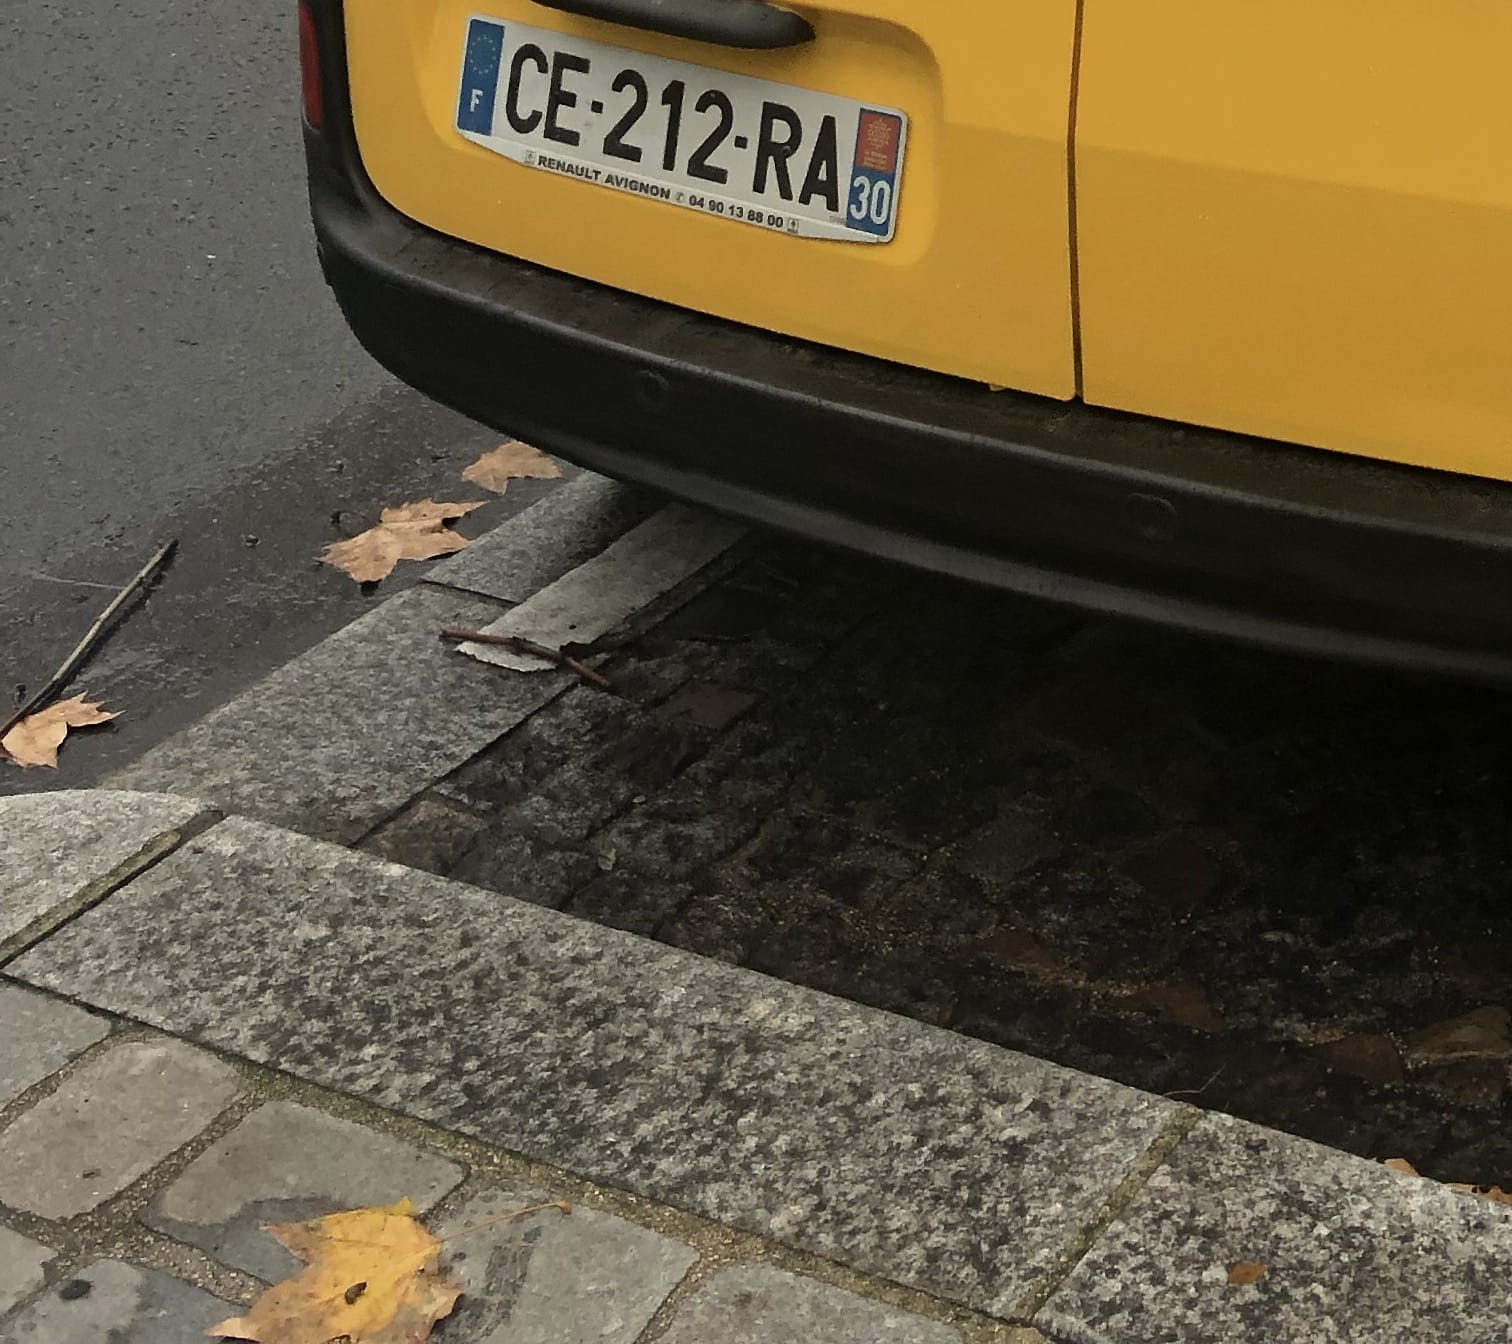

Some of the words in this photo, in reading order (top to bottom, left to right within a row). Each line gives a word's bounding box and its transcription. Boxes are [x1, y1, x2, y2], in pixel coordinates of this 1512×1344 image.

[470, 89, 483, 112] F
[505, 43, 840, 212] CE-212-RA
[538, 155, 602, 181] RENAULT
[604, 174, 671, 200] AVIGNON
[689, 194, 704, 209] 04
[708, 199, 724, 213] 90
[728, 204, 744, 218] 13
[747, 209, 763, 223] 88
[767, 214, 784, 228] 00
[850, 175, 892, 226] 30
